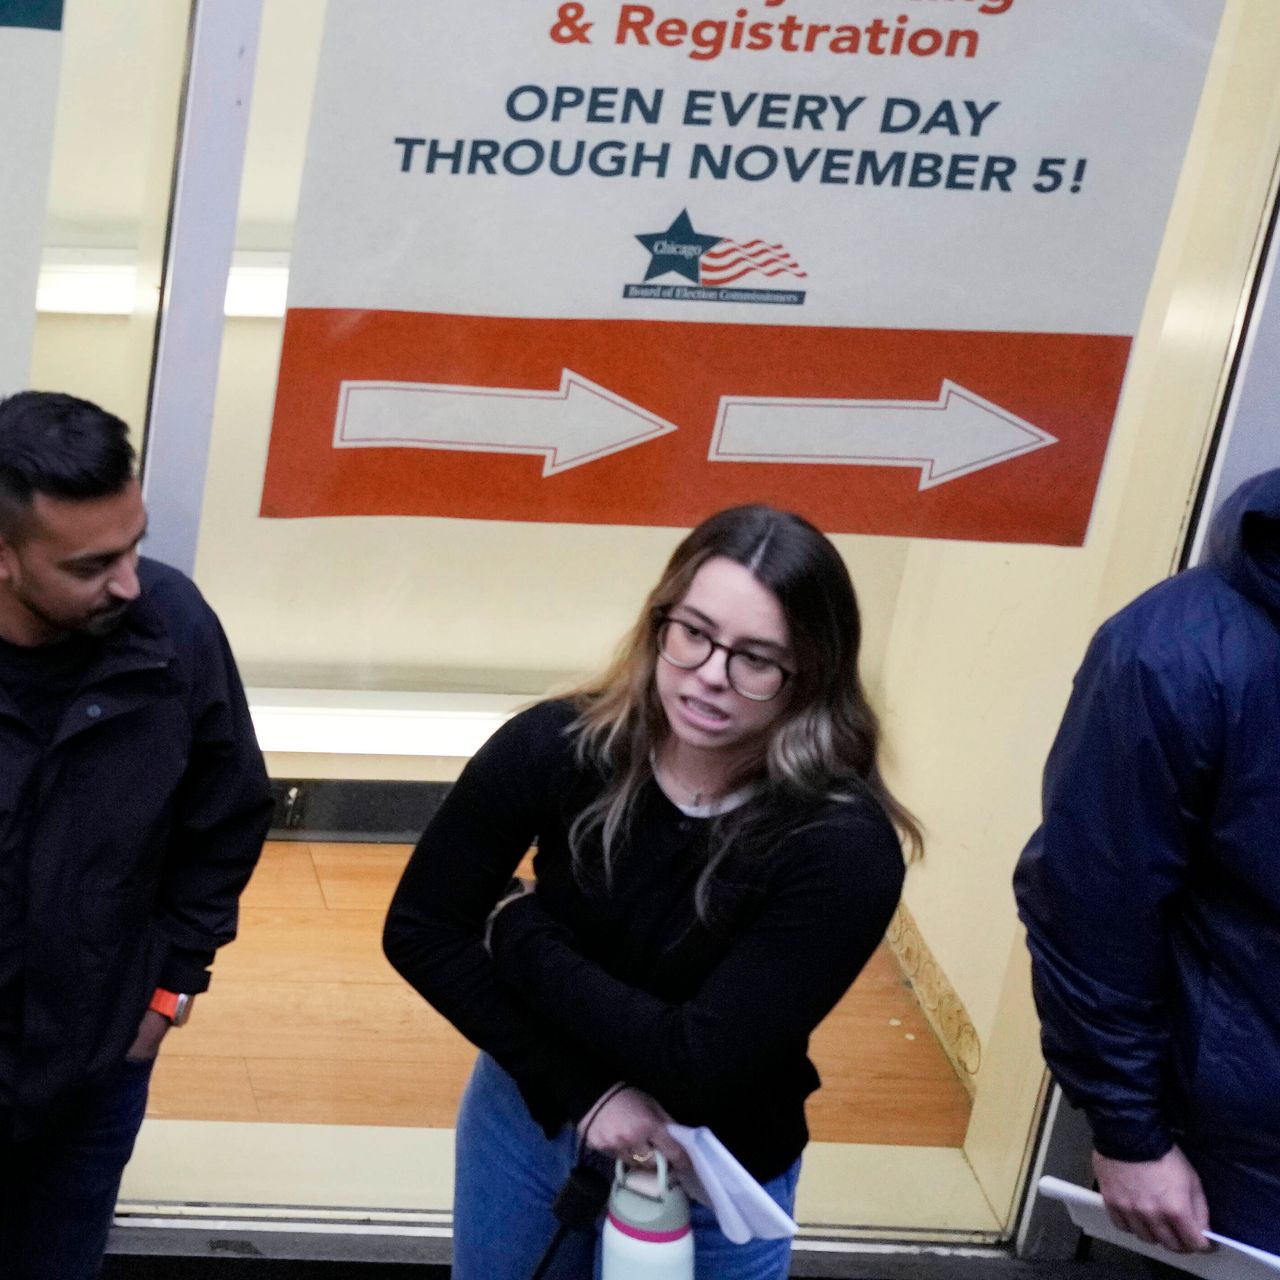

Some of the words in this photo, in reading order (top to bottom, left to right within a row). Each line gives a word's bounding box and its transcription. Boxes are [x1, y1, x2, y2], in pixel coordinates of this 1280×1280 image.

[550, 2, 593, 44] &
[616, 4, 978, 60] Registration
[506, 85, 664, 124] OPEN
[683, 90, 866, 131] EVERY
[880, 98, 1000, 136] DAY
[395, 137, 670, 178] THROUGH
[690, 144, 1016, 192] NOVEMBER
[1033, 158, 1087, 193] 5!
[653, 240, 702, 260] Chicago
[628, 286, 661, 297] Board
[662, 287, 674, 298] of
[675, 287, 718, 300] Election
[719, 289, 798, 303] Commissioners
